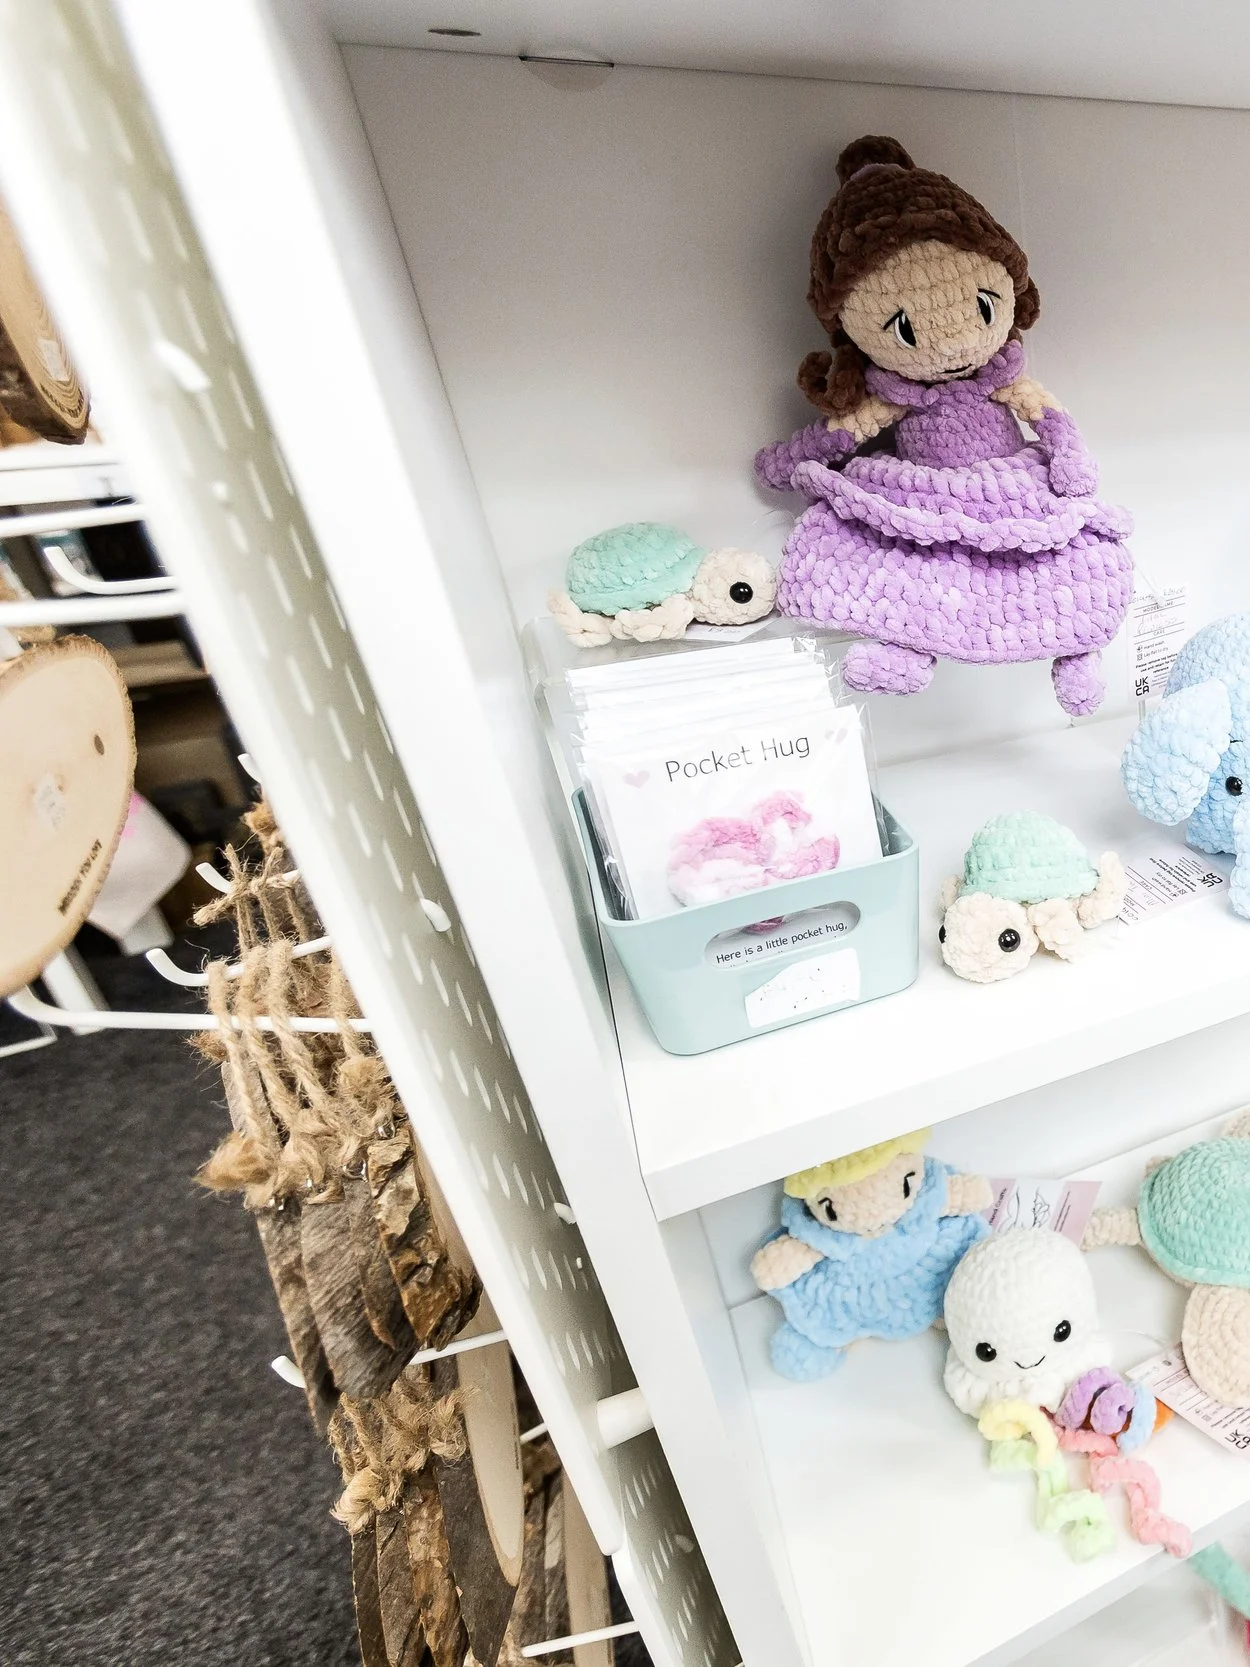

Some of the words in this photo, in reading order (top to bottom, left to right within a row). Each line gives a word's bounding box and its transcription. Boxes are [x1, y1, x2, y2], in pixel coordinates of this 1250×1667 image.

[1135, 676, 1148, 687] UK
[1136, 685, 1149, 696] CA
[665, 745, 752, 782] Pocket
[761, 736, 810, 761] Hug
[1197, 876, 1214, 888] UK
[1206, 872, 1223, 884] CA
[716, 949, 741, 964] Here
[744, 942, 754, 956] is
[756, 945, 763, 953] a
[765, 935, 788, 950] little
[791, 927, 823, 944] pocket
[825, 921, 848, 934] hug,
[1225, 1429, 1243, 1442] UK
